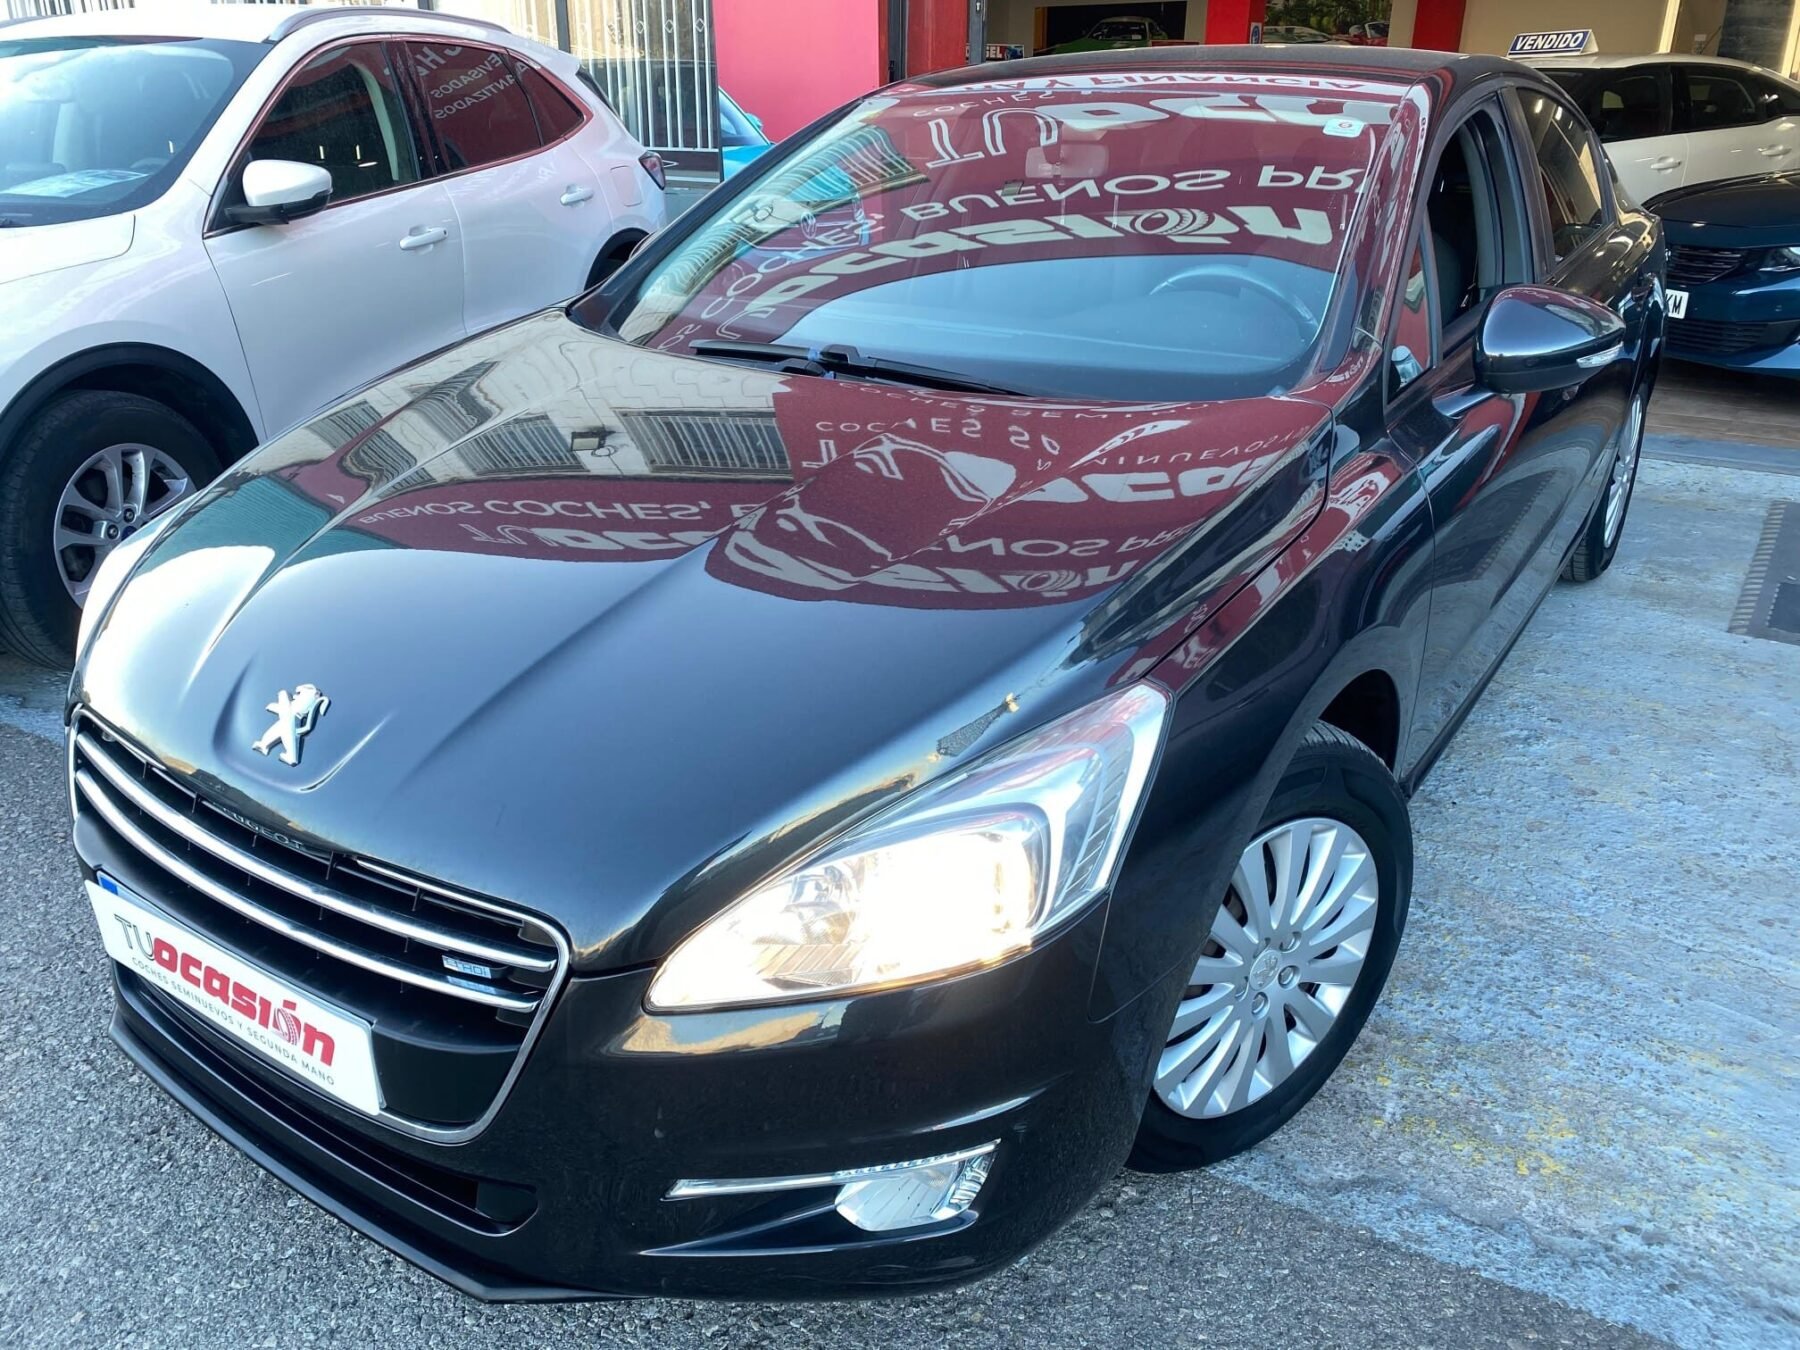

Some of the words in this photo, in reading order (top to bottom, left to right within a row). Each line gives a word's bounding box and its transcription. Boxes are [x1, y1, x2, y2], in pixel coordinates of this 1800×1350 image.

[1515, 32, 1584, 51] VENDIDO
[131, 956, 169, 985] COCHES
[171, 980, 234, 1025] SEMINUEVOS
[246, 1026, 298, 1063] SEGUNDA
[301, 1060, 335, 1086] MANO
